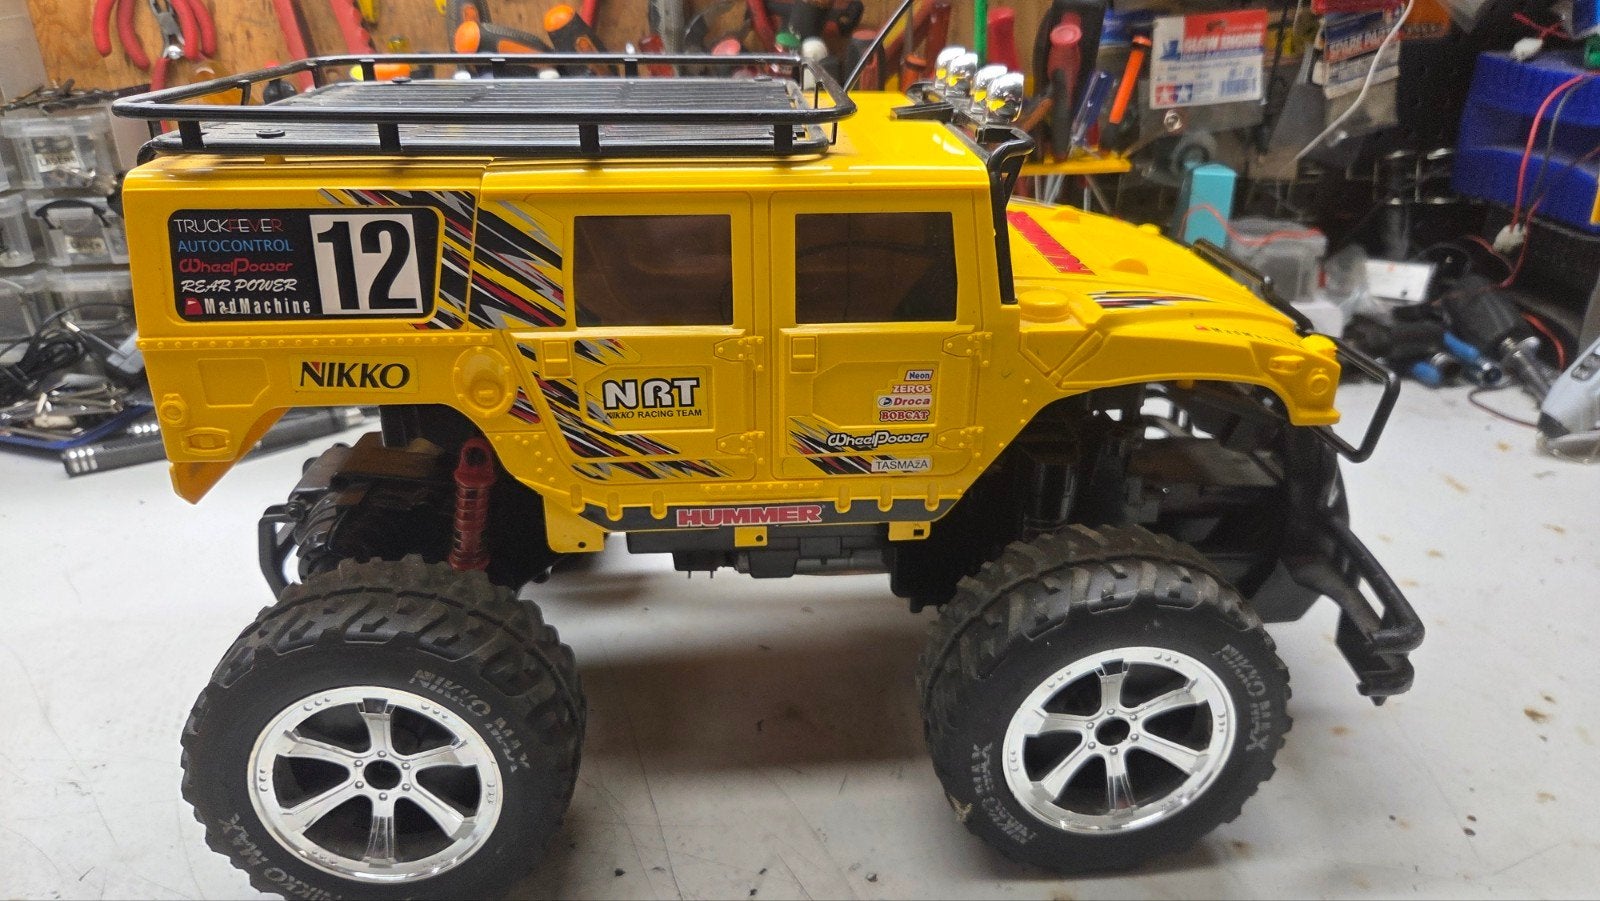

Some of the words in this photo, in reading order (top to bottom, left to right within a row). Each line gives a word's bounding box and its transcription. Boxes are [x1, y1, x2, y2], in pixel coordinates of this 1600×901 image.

[174, 218, 283, 233] TRUCKFEVER
[178, 239, 293, 252] AUTOCONTROL
[179, 258, 293, 276] WheelPower
[316, 219, 418, 310] 12
[180, 279, 231, 293] REAR
[233, 278, 298, 292] POWER
[300, 361, 411, 389] NIKKO
[909, 371, 930, 380] Neon
[602, 377, 700, 410] NRT
[892, 384, 932, 394] ZEROS
[893, 397, 931, 406] Droca
[606, 411, 635, 419] NIKKO
[880, 411, 930, 421] BOBCAT
[827, 430, 929, 448] WheelPower
[676, 504, 823, 527] HUMMER
